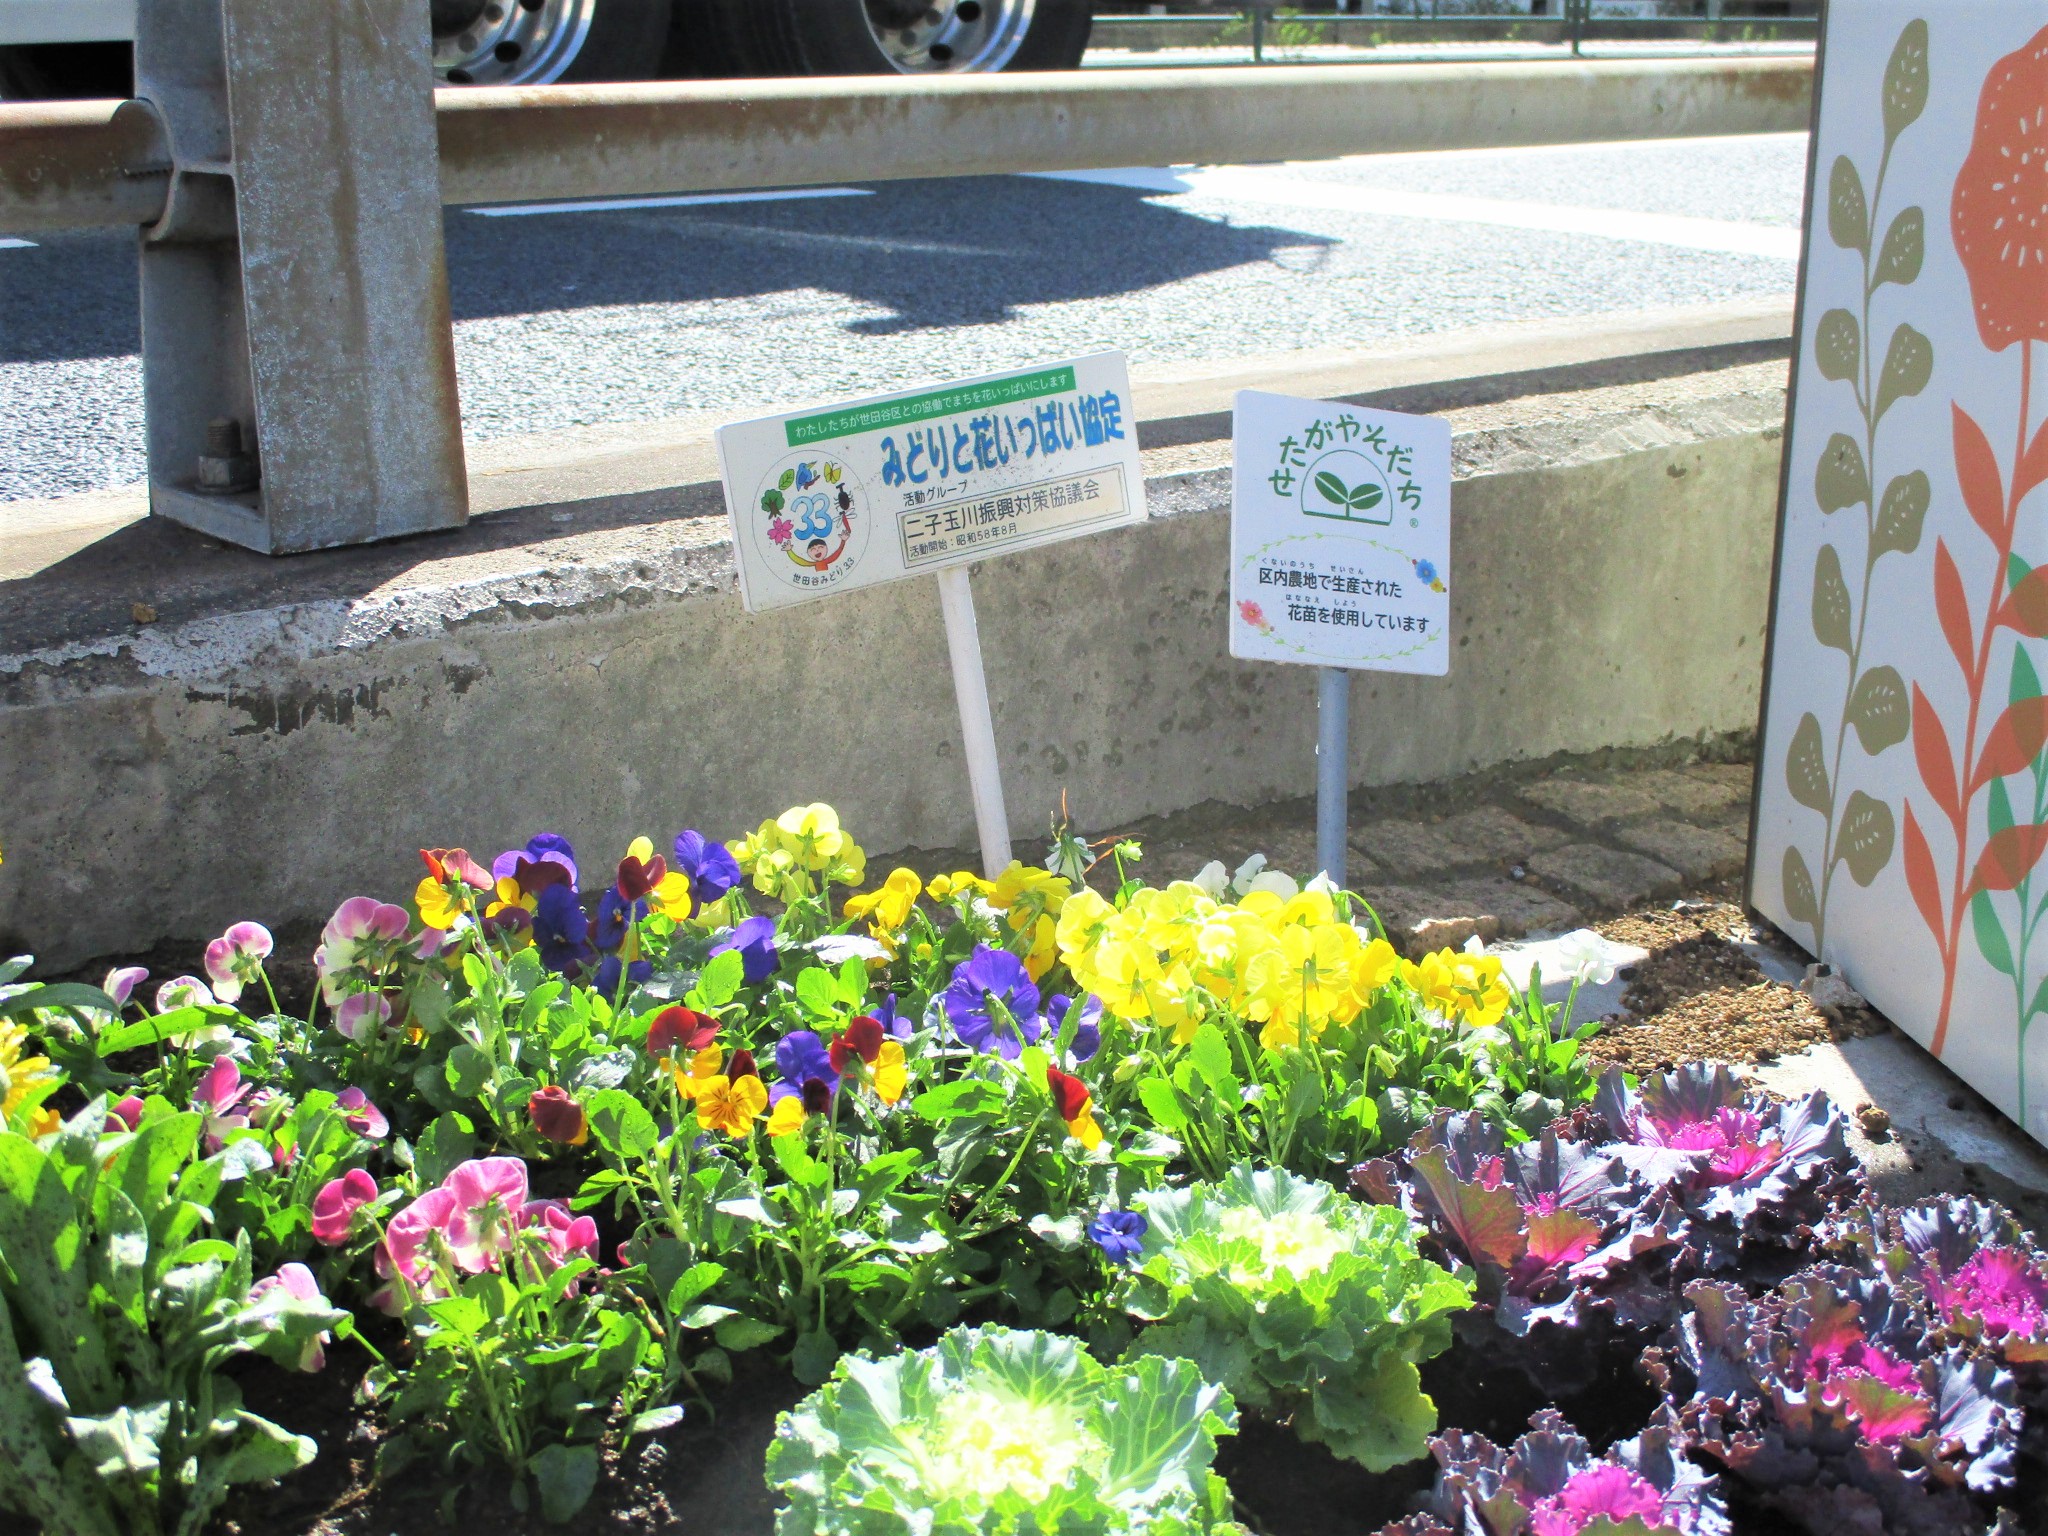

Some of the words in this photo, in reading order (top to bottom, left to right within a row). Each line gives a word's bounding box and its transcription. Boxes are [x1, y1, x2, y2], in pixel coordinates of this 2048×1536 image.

[880, 389, 1126, 488] みどりと花いっぱい協定
[1268, 413, 1422, 511] せたがやそだち
[791, 493, 833, 541] 33
[902, 480, 968, 508] 活動グループ
[906, 478, 1101, 539] 二子玉川振興対策協議会
[1258, 567, 1403, 599] 区内農地で生産された
[1287, 603, 1430, 634] 花苗を使用しています
